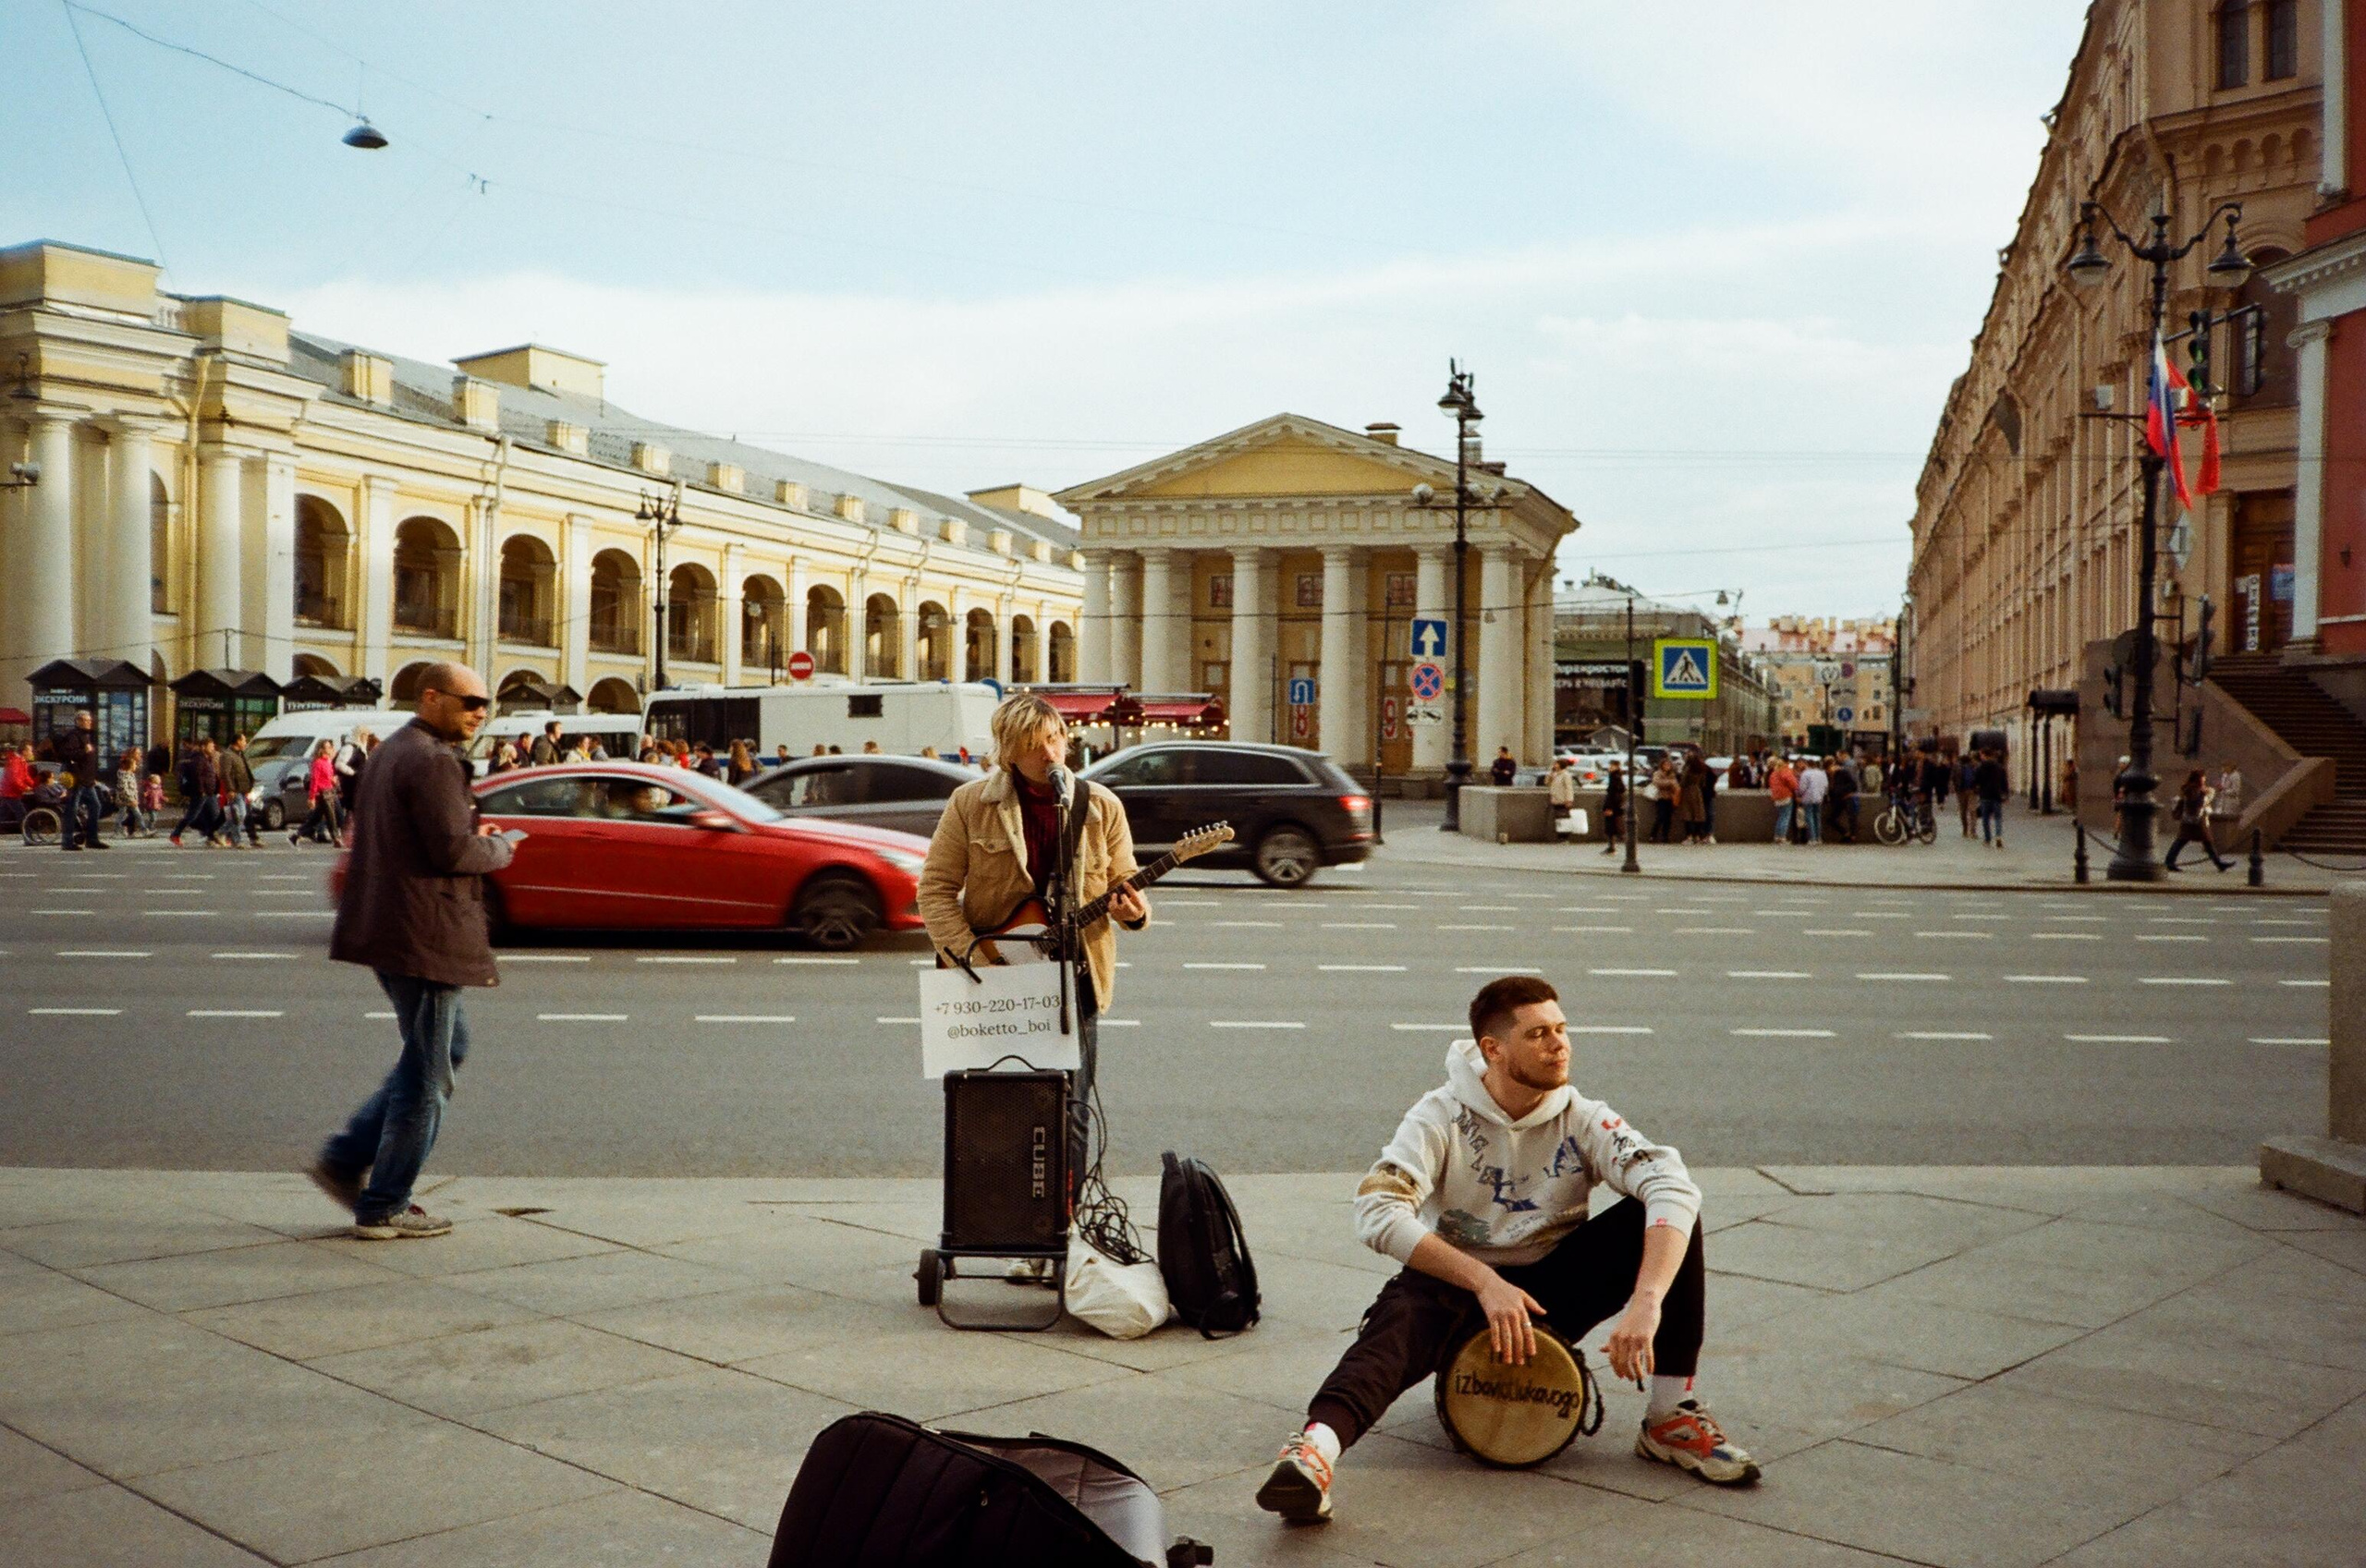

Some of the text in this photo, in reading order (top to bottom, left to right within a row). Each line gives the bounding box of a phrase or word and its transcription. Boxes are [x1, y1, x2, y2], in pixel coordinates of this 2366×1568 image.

[34, 695, 87, 703] ЭКСКУРСИИ
[954, 995, 1060, 1015] 930-220-17-03
[947, 1020, 1051, 1039] @boketto_boi
[1032, 1126, 1045, 1197] CUBE
